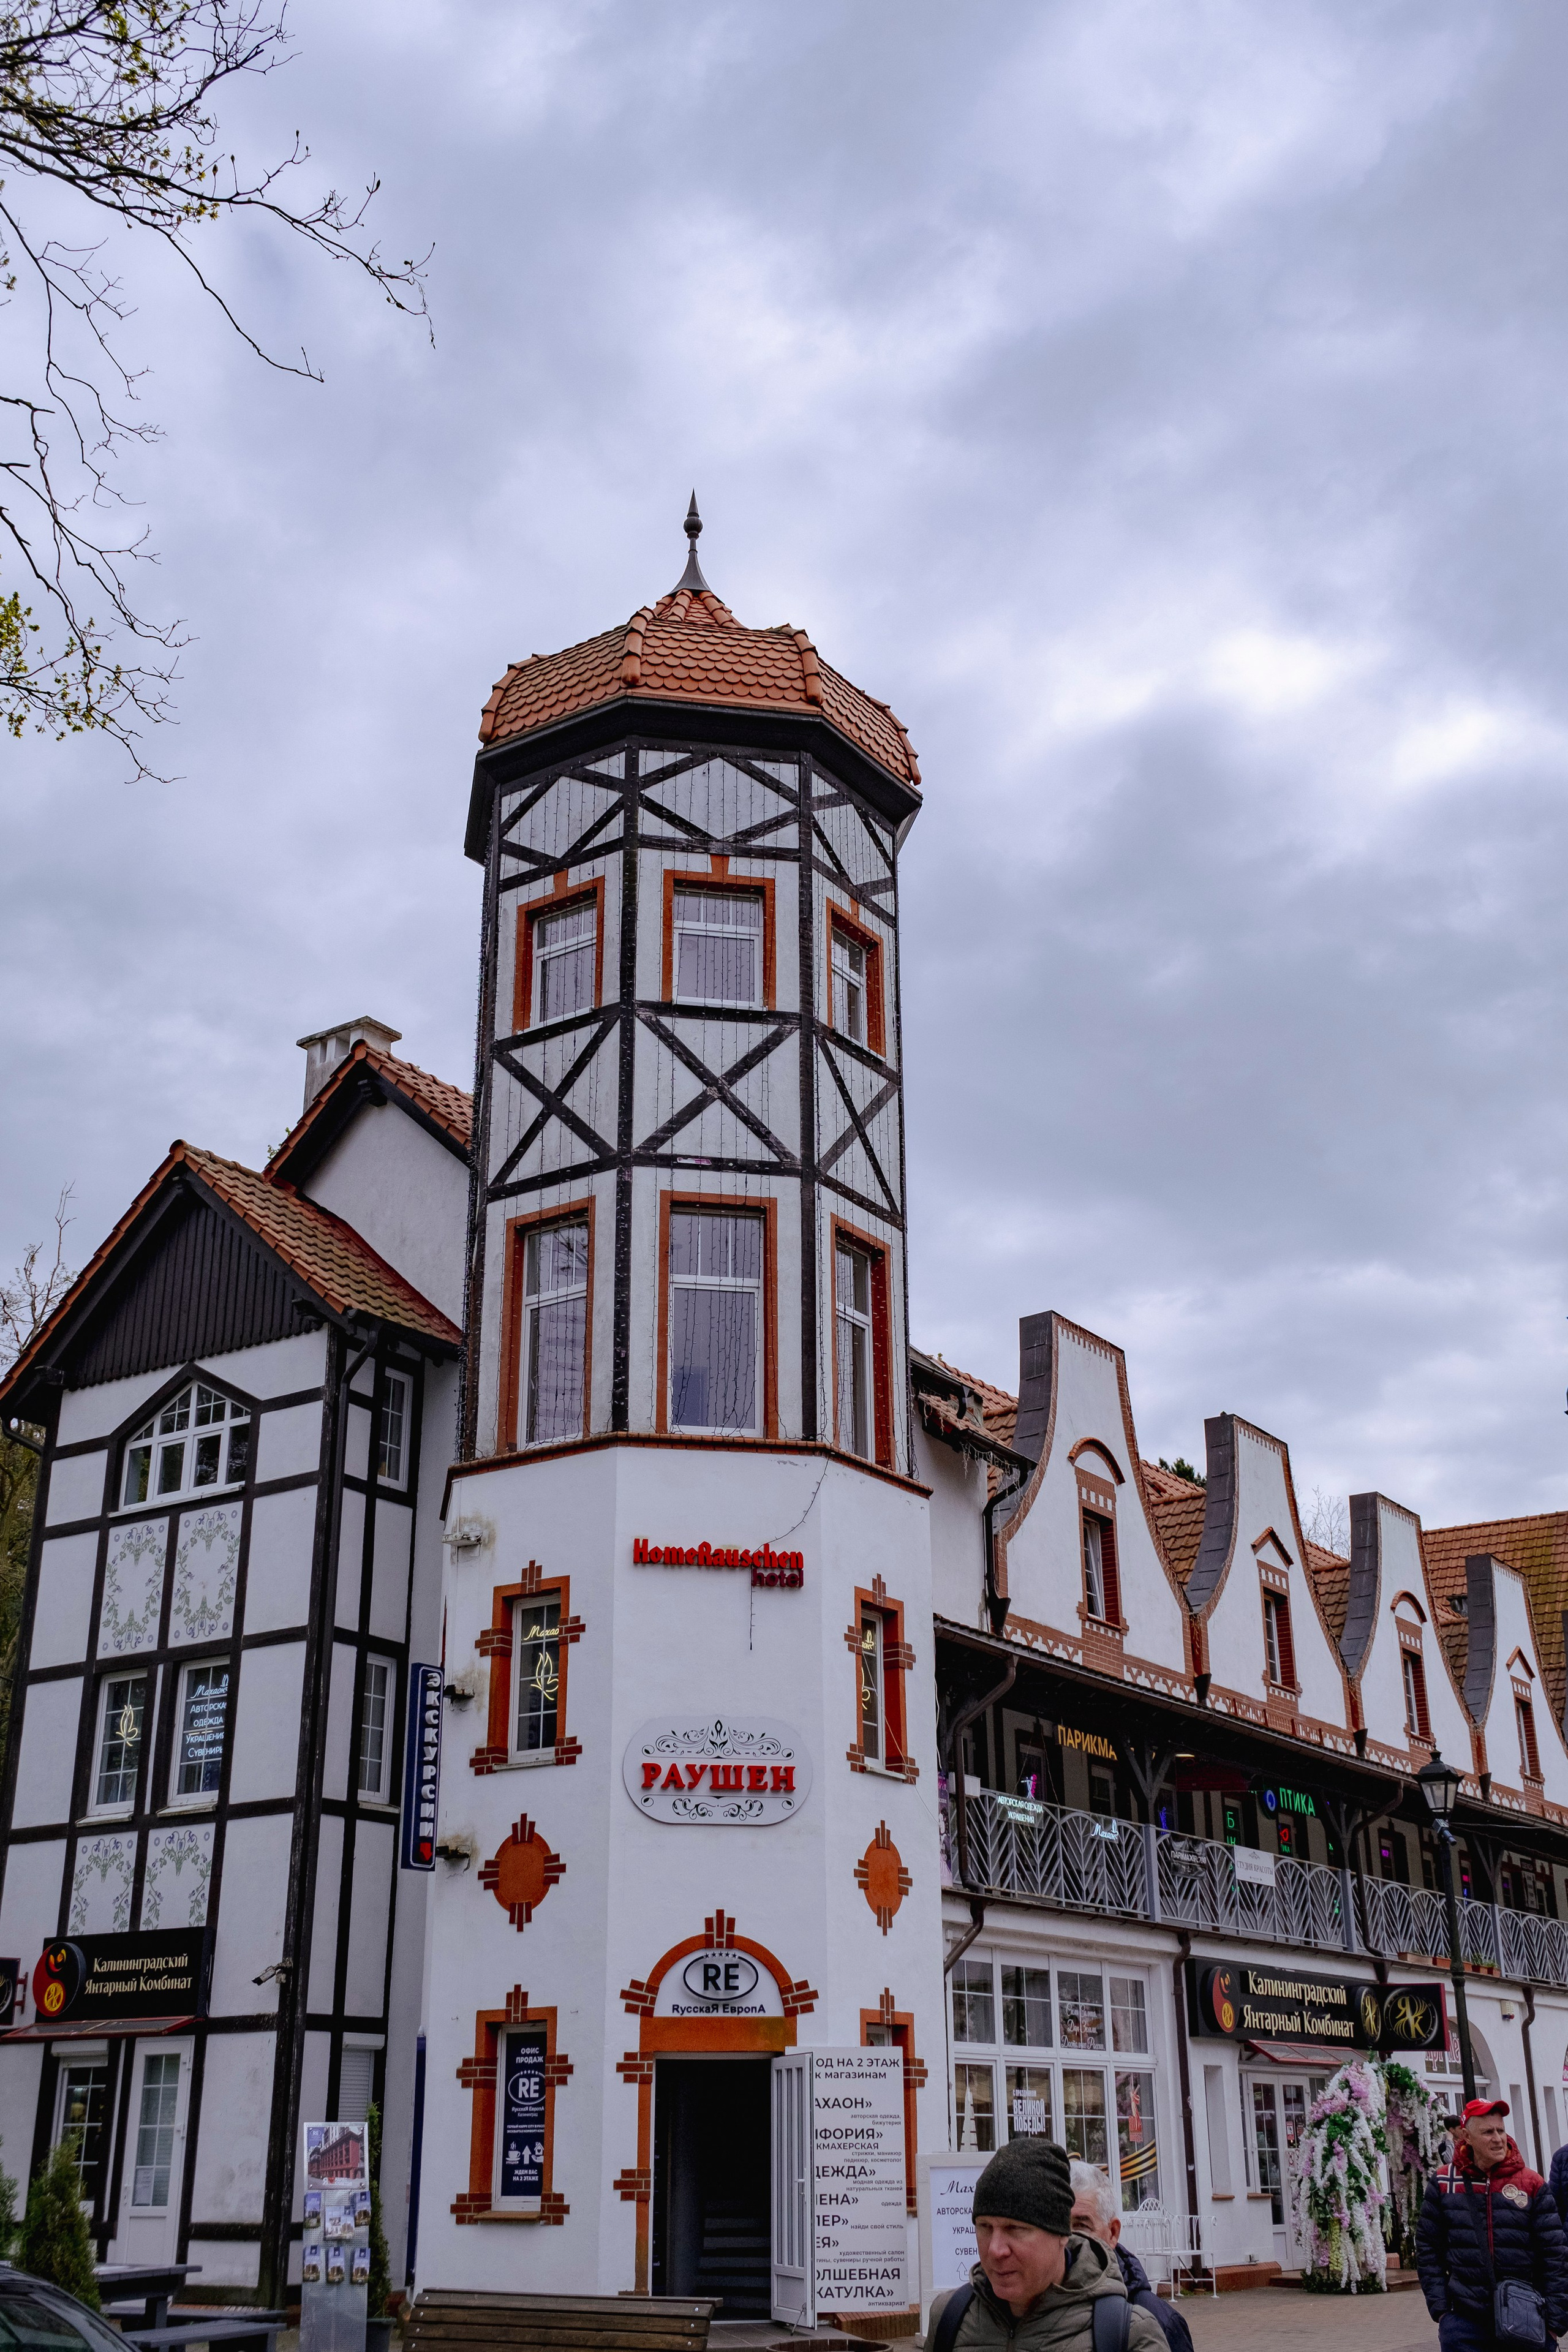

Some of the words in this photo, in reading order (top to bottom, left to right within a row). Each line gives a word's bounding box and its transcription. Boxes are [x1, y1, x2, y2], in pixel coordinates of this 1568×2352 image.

[633, 1538, 804, 1569] HomeRauschen
[752, 1569, 804, 1588] hotel
[524, 1625, 559, 1640] Махао
[190, 1702, 227, 1714] АВТОРСКА
[1058, 1725, 1118, 1760] ПАРИКМА
[419, 1673, 440, 1838] ЭКСКУРСИИ
[641, 1763, 796, 1791] РАУШЕН
[998, 1796, 1023, 1808] АВТОРСКАЯ
[1024, 1802, 1043, 1813] ОДЕЖДА
[1008, 1811, 1035, 1824] УКРАШЕНИЯ
[1236, 1861, 1253, 1871] СТУДИЯ
[1254, 1864, 1273, 1875] КРАСОТЫ
[94, 1954, 189, 1973] Калининградский
[84, 1978, 137, 1997] Янтарный
[140, 1975, 192, 1991] Комбинат
[704, 1964, 739, 1991] RE
[1248, 1970, 1347, 2007] Калининградский
[723, 2004, 766, 2015] ЕвропА
[1243, 2004, 1302, 2036] Янтарный
[1304, 2011, 1354, 2038] Комбинат
[815, 2058, 834, 2068] ОД
[837, 2058, 854, 2067] НА
[857, 2058, 863, 2067] 2
[866, 2059, 900, 2067] ЭТАЖ
[518, 2078, 539, 2098] RE
[815, 2097, 872, 2109] АХАОН»
[1013, 2098, 1045, 2115] ВЕЛИКОЙ
[815, 2128, 883, 2140] ФОРИЯ»
[1014, 2116, 1046, 2135] ПОБЕДЫ!
[816, 2166, 876, 2179] ЕЖДА»
[940, 2180, 974, 2195] Мах
[816, 2286, 894, 2298] КАТУЛКА»
